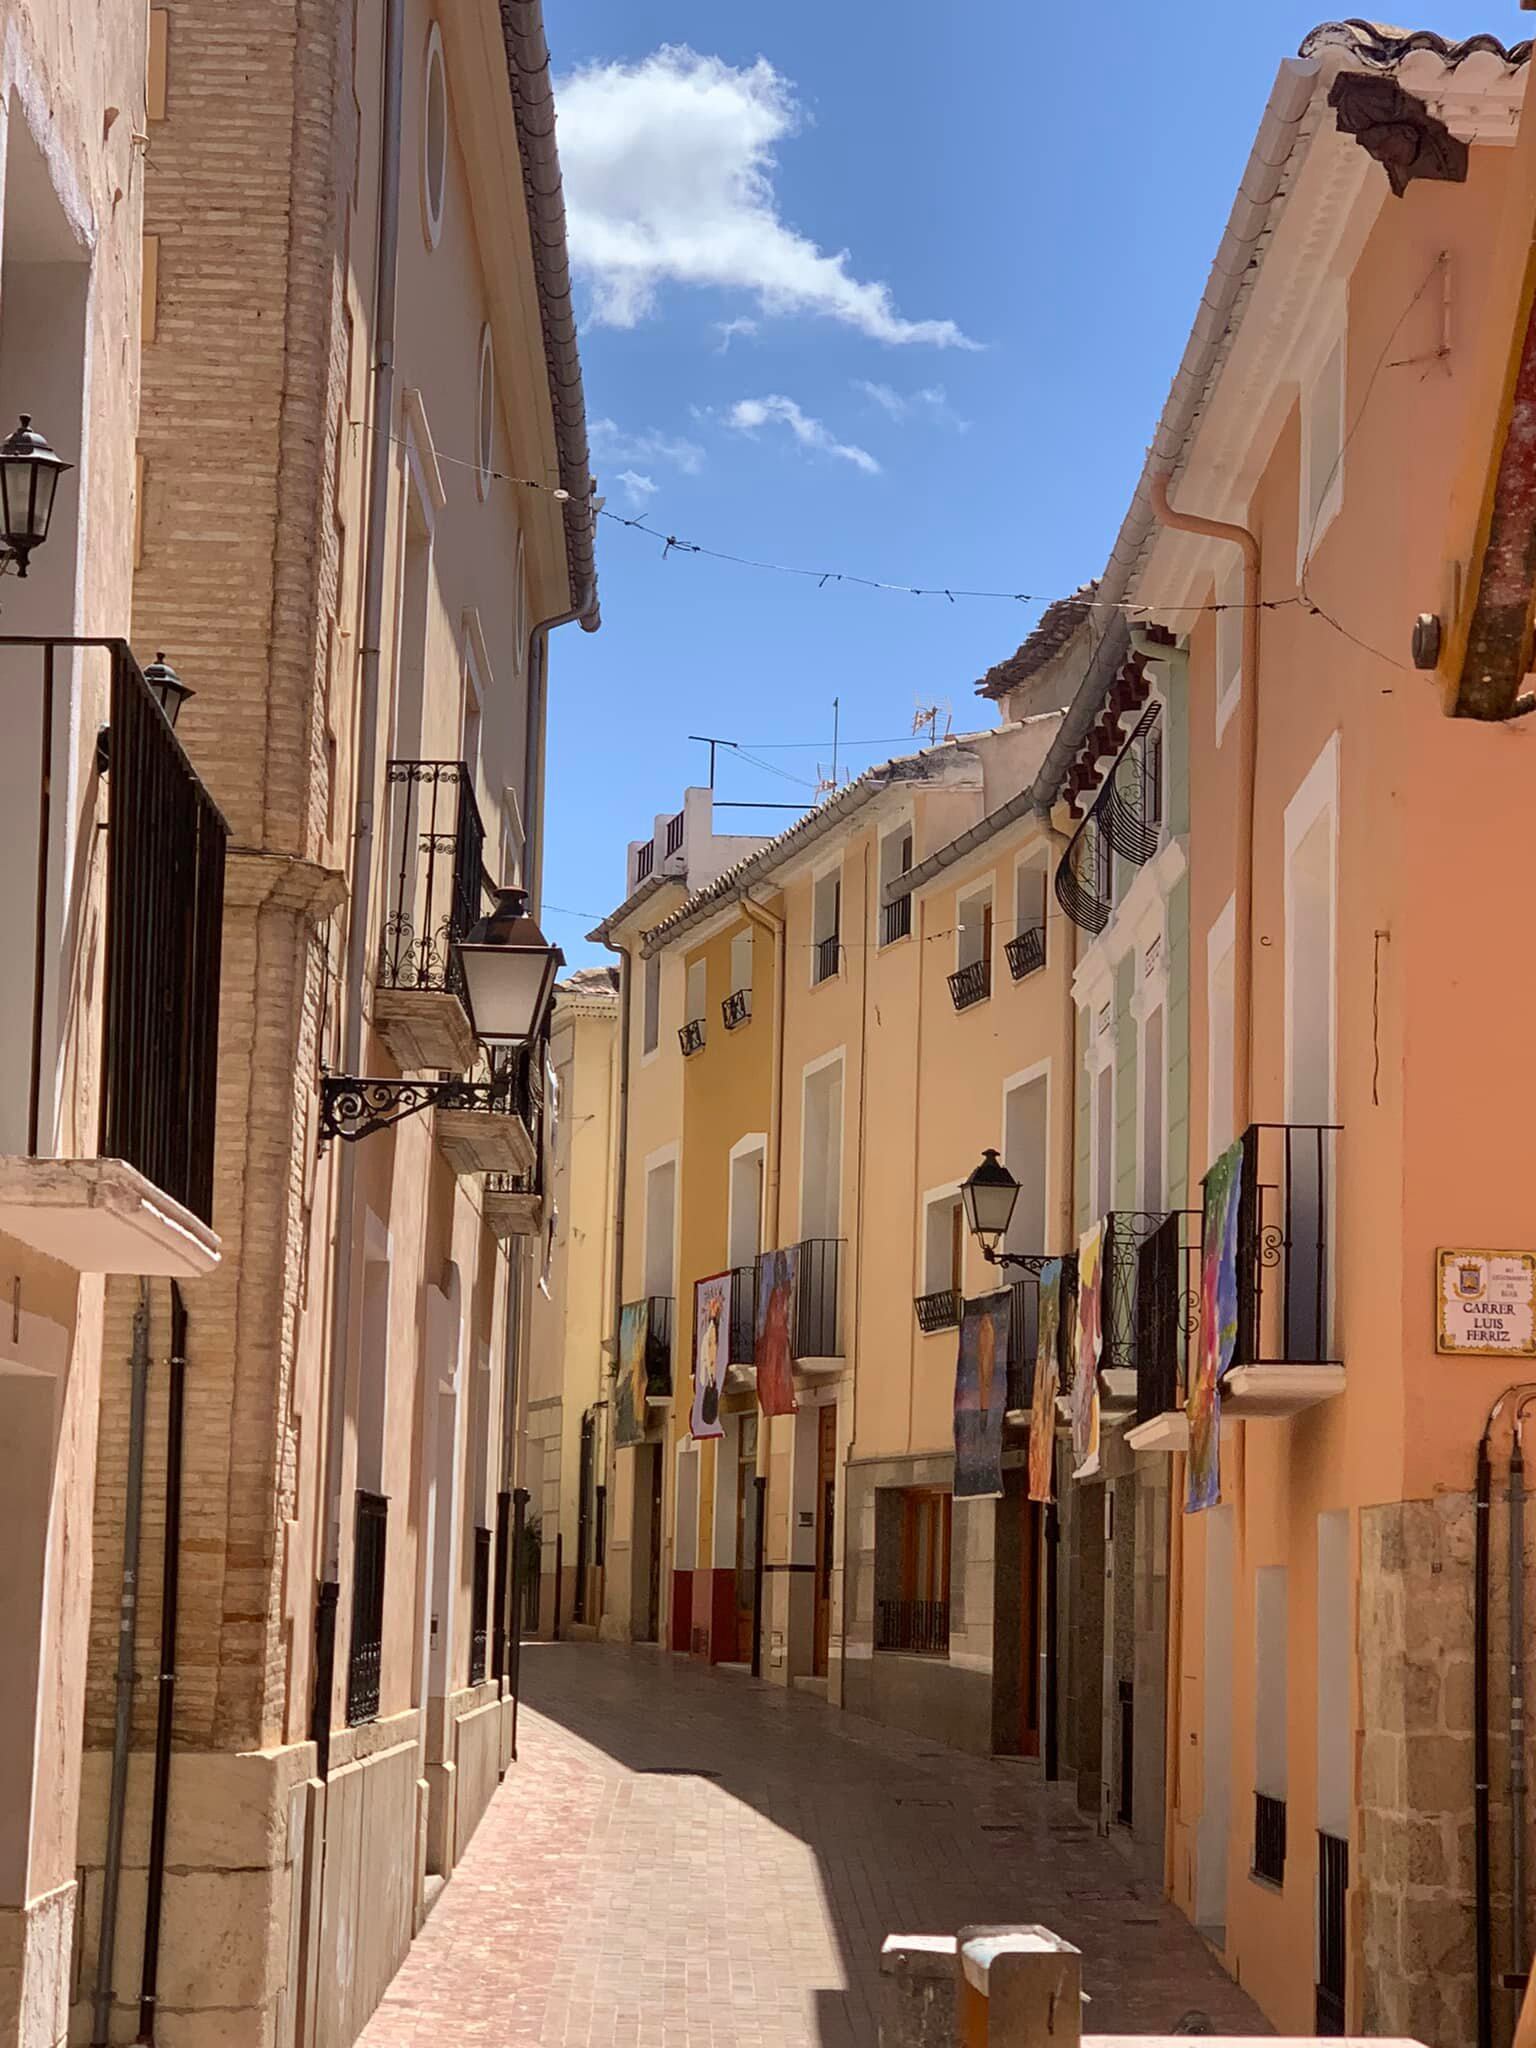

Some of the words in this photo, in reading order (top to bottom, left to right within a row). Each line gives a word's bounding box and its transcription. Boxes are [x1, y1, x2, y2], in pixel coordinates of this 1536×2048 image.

[1463, 1302, 1516, 1315] CARRER
[1474, 1318, 1503, 1329] LUIS
[1467, 1330, 1510, 1342] FERRIZ
